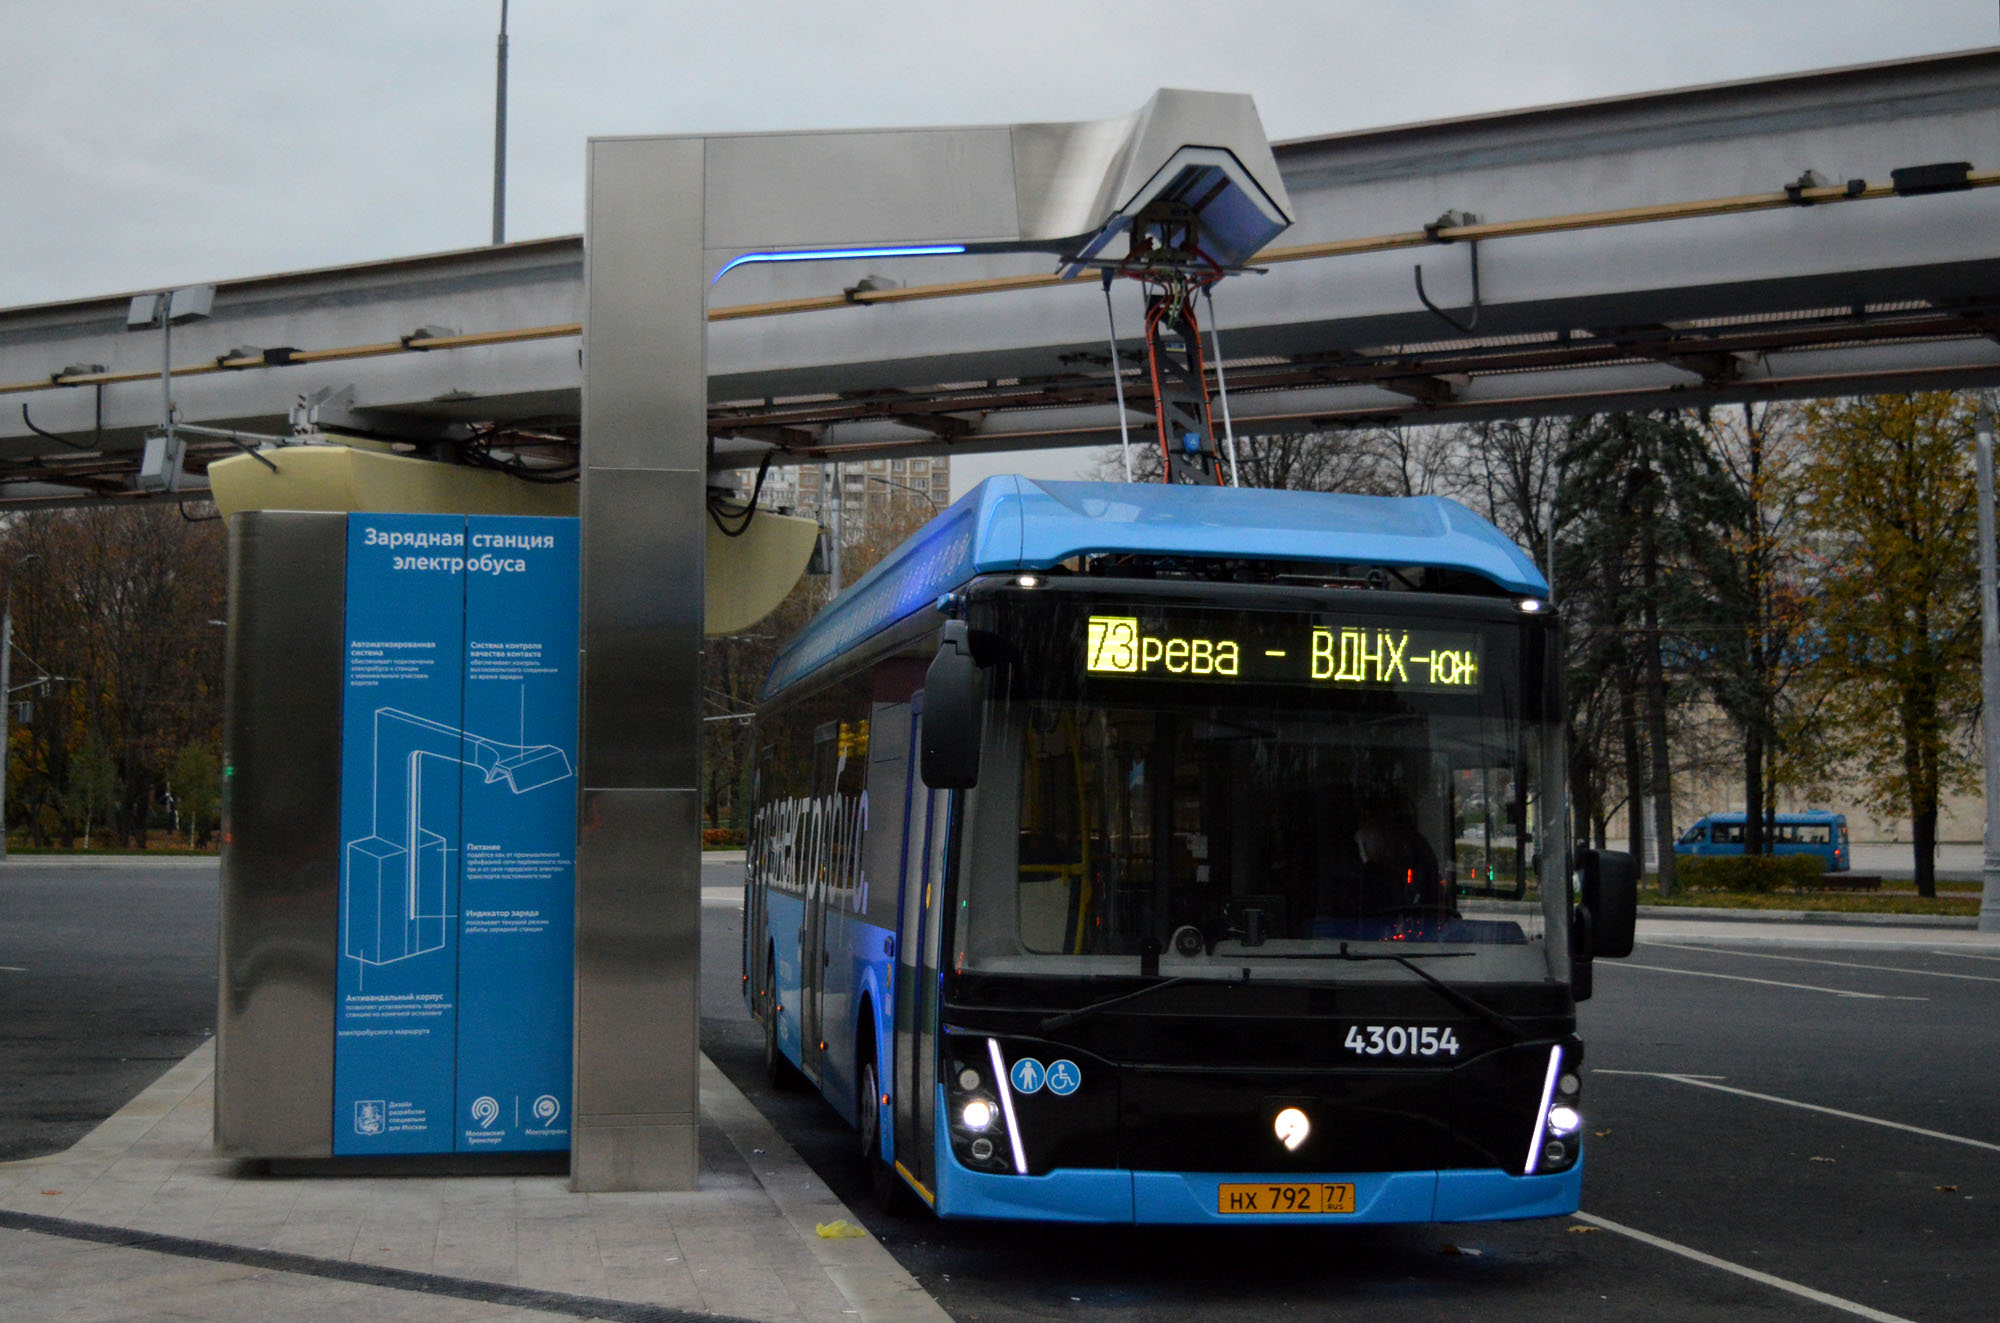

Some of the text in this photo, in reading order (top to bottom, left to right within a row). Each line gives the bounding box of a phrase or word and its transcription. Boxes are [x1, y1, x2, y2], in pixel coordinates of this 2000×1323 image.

[364, 528, 555, 552] Зарядная станция
[393, 554, 526, 576] электробуса
[350, 640, 436, 649] Автоматизированная
[470, 641, 504, 649] Система
[1088, 622, 1136, 669] 73
[1142, 637, 1239, 676] рева
[467, 843, 501, 851] Питание
[346, 993, 444, 1002] Антивандальный корпус
[1344, 1025, 1460, 1056] 430154
[1268, 1187, 1311, 1210] 792
[1324, 1185, 1347, 1203] 77
[1327, 1203, 1344, 1211] RUS
